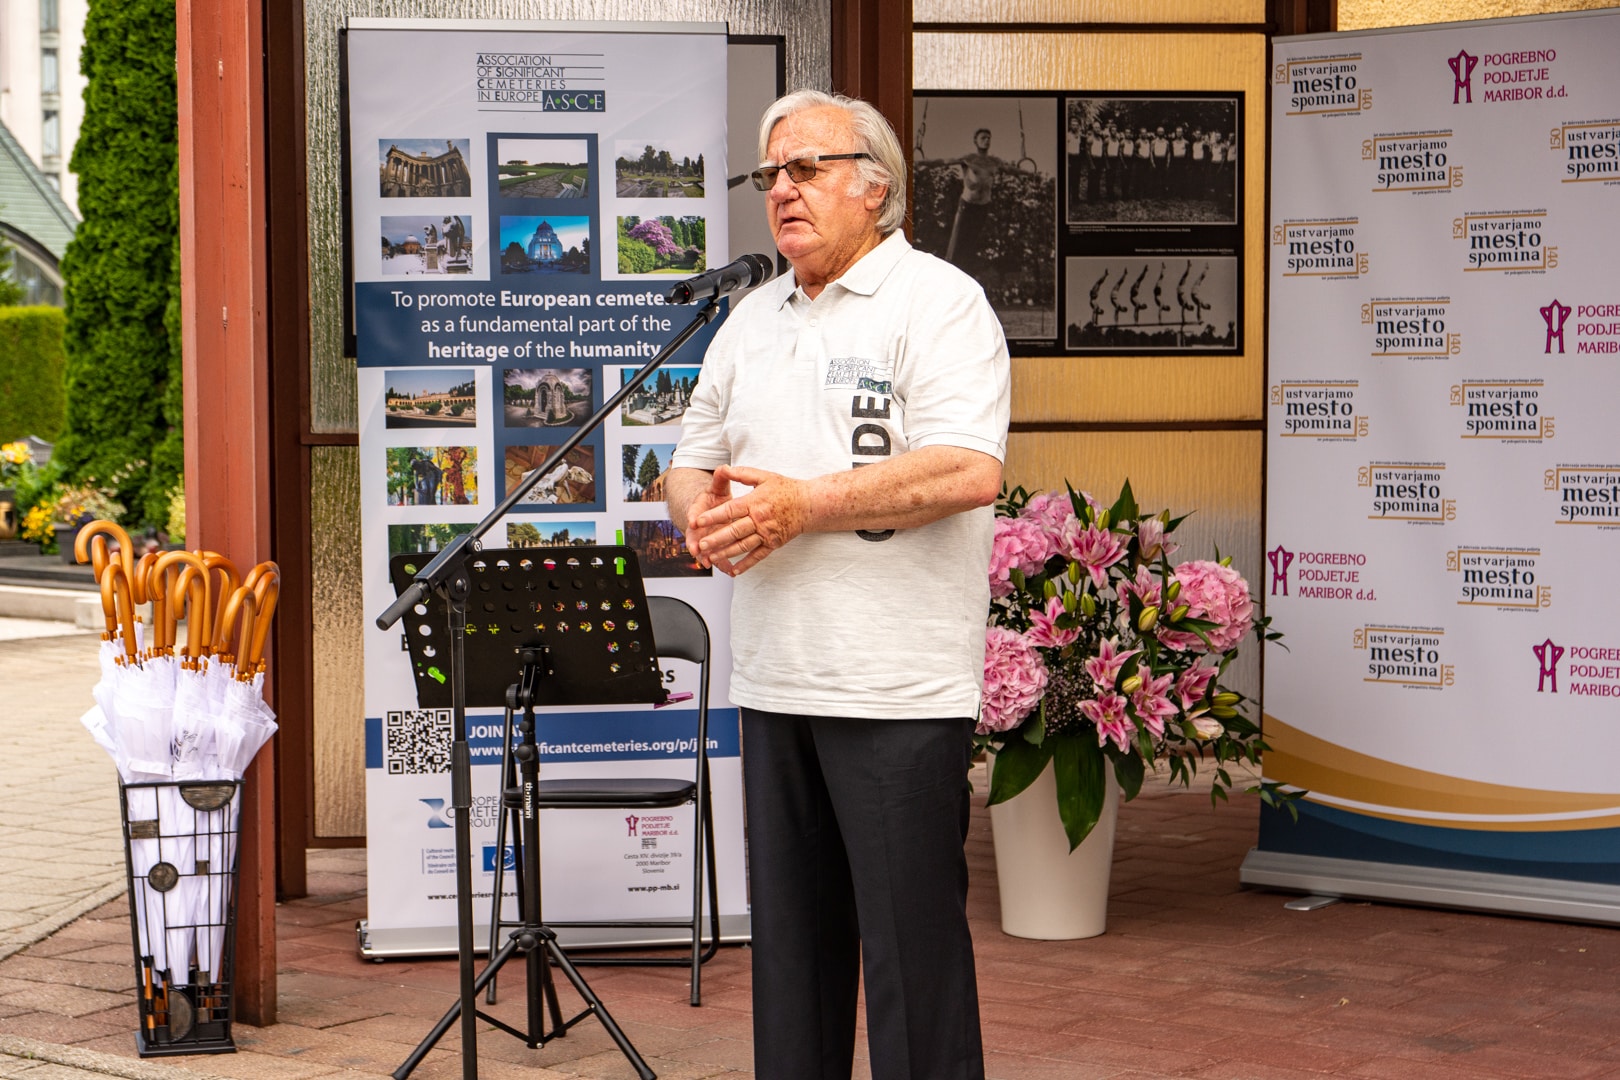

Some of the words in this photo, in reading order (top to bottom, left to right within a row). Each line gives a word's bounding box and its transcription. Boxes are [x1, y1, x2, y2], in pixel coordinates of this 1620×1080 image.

[477, 55, 551, 65] ASSOCIATION
[1483, 49, 1556, 67] POGREBNO
[477, 67, 492, 77] OF
[496, 67, 565, 77] SIGNIFICANT
[1483, 68, 1550, 85] PODJETJE
[477, 79, 566, 89] CEMETERIES
[1293, 74, 1357, 94] mesto
[478, 91, 490, 101] IN
[495, 91, 539, 101] EUROPE
[1291, 90, 1356, 112] spomina
[1483, 86, 1543, 103] MARIBOR
[1546, 84, 1568, 98] d.d.
[1568, 127, 1620, 141] ustvarja
[1569, 140, 1620, 160] mes
[1379, 151, 1447, 170] mesto
[1567, 156, 1619, 180] spomi
[1377, 167, 1446, 190] spomina
[1289, 238, 1354, 255] mesto
[1470, 231, 1541, 249] mesto
[1287, 253, 1354, 274] spomina
[1469, 246, 1540, 268] spomina
[391, 291, 413, 307] To
[418, 292, 496, 311] promote
[501, 290, 591, 310] European
[596, 291, 698, 306] cemete
[1577, 304, 1620, 318] POGRE
[421, 319, 440, 333] as
[444, 319, 455, 333] a
[459, 315, 573, 333] fundamental
[578, 317, 615, 336] part
[620, 314, 638, 332] of
[641, 314, 672, 331] the
[1376, 317, 1445, 335] mesto
[1577, 322, 1620, 336] PODJE
[428, 341, 509, 362] heritage
[513, 341, 532, 358] of
[535, 341, 566, 358] the
[1375, 332, 1443, 353] spomina
[1577, 341, 1620, 354] MARIB
[1286, 400, 1353, 416] mesto
[1468, 400, 1538, 417] mesto
[1285, 415, 1351, 434] spomina
[1466, 416, 1537, 436] spomina
[1562, 472, 1620, 486] ustvarja
[1375, 482, 1440, 499] mesto
[1563, 485, 1620, 503] mest
[1373, 497, 1439, 516] spomina
[1299, 552, 1366, 566] POGREBNO
[1299, 569, 1359, 583] PODJETJE
[1463, 568, 1535, 585] mesto
[1299, 585, 1353, 600] MARIBOR
[1356, 588, 1377, 601] d.d.
[1462, 583, 1533, 603] spomina
[1370, 646, 1439, 664] mesto
[1368, 661, 1437, 680] spomina
[1570, 664, 1620, 679] PODJET
[1569, 682, 1620, 698] MARIBO
[469, 725, 504, 739] JOIN
[628, 883, 680, 893] www.pp-mb.si
